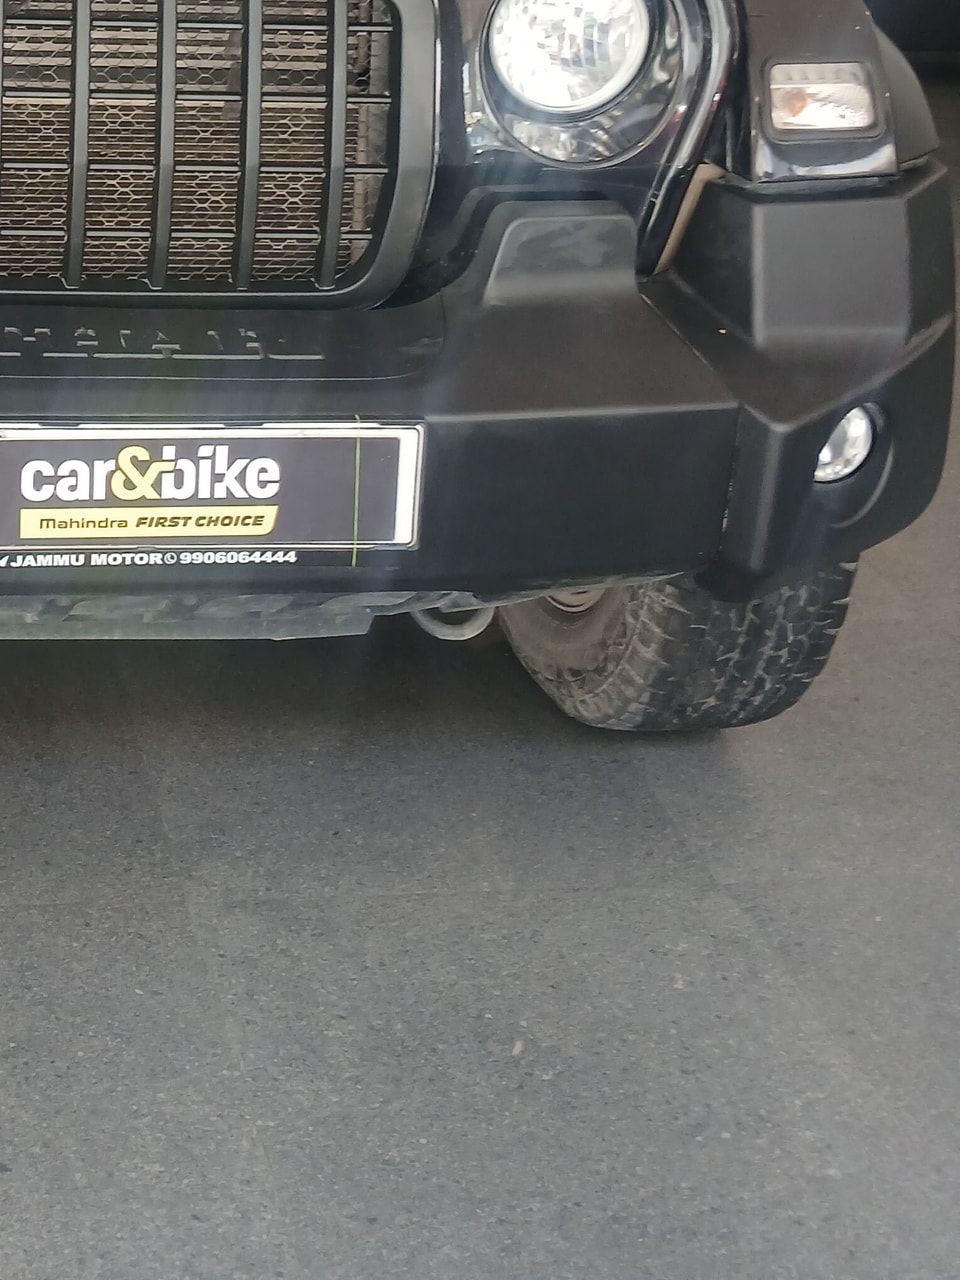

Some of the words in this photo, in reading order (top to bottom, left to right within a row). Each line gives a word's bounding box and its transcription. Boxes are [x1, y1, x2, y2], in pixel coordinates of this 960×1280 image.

[20, 444, 281, 502] car&bike
[39, 517, 129, 529] Mahindra
[135, 516, 192, 528] FIRST
[194, 515, 265, 527] CHOICE
[10, 553, 85, 568] JAMMU
[90, 552, 163, 566] MOTOR
[179, 551, 297, 565] 9906064444
